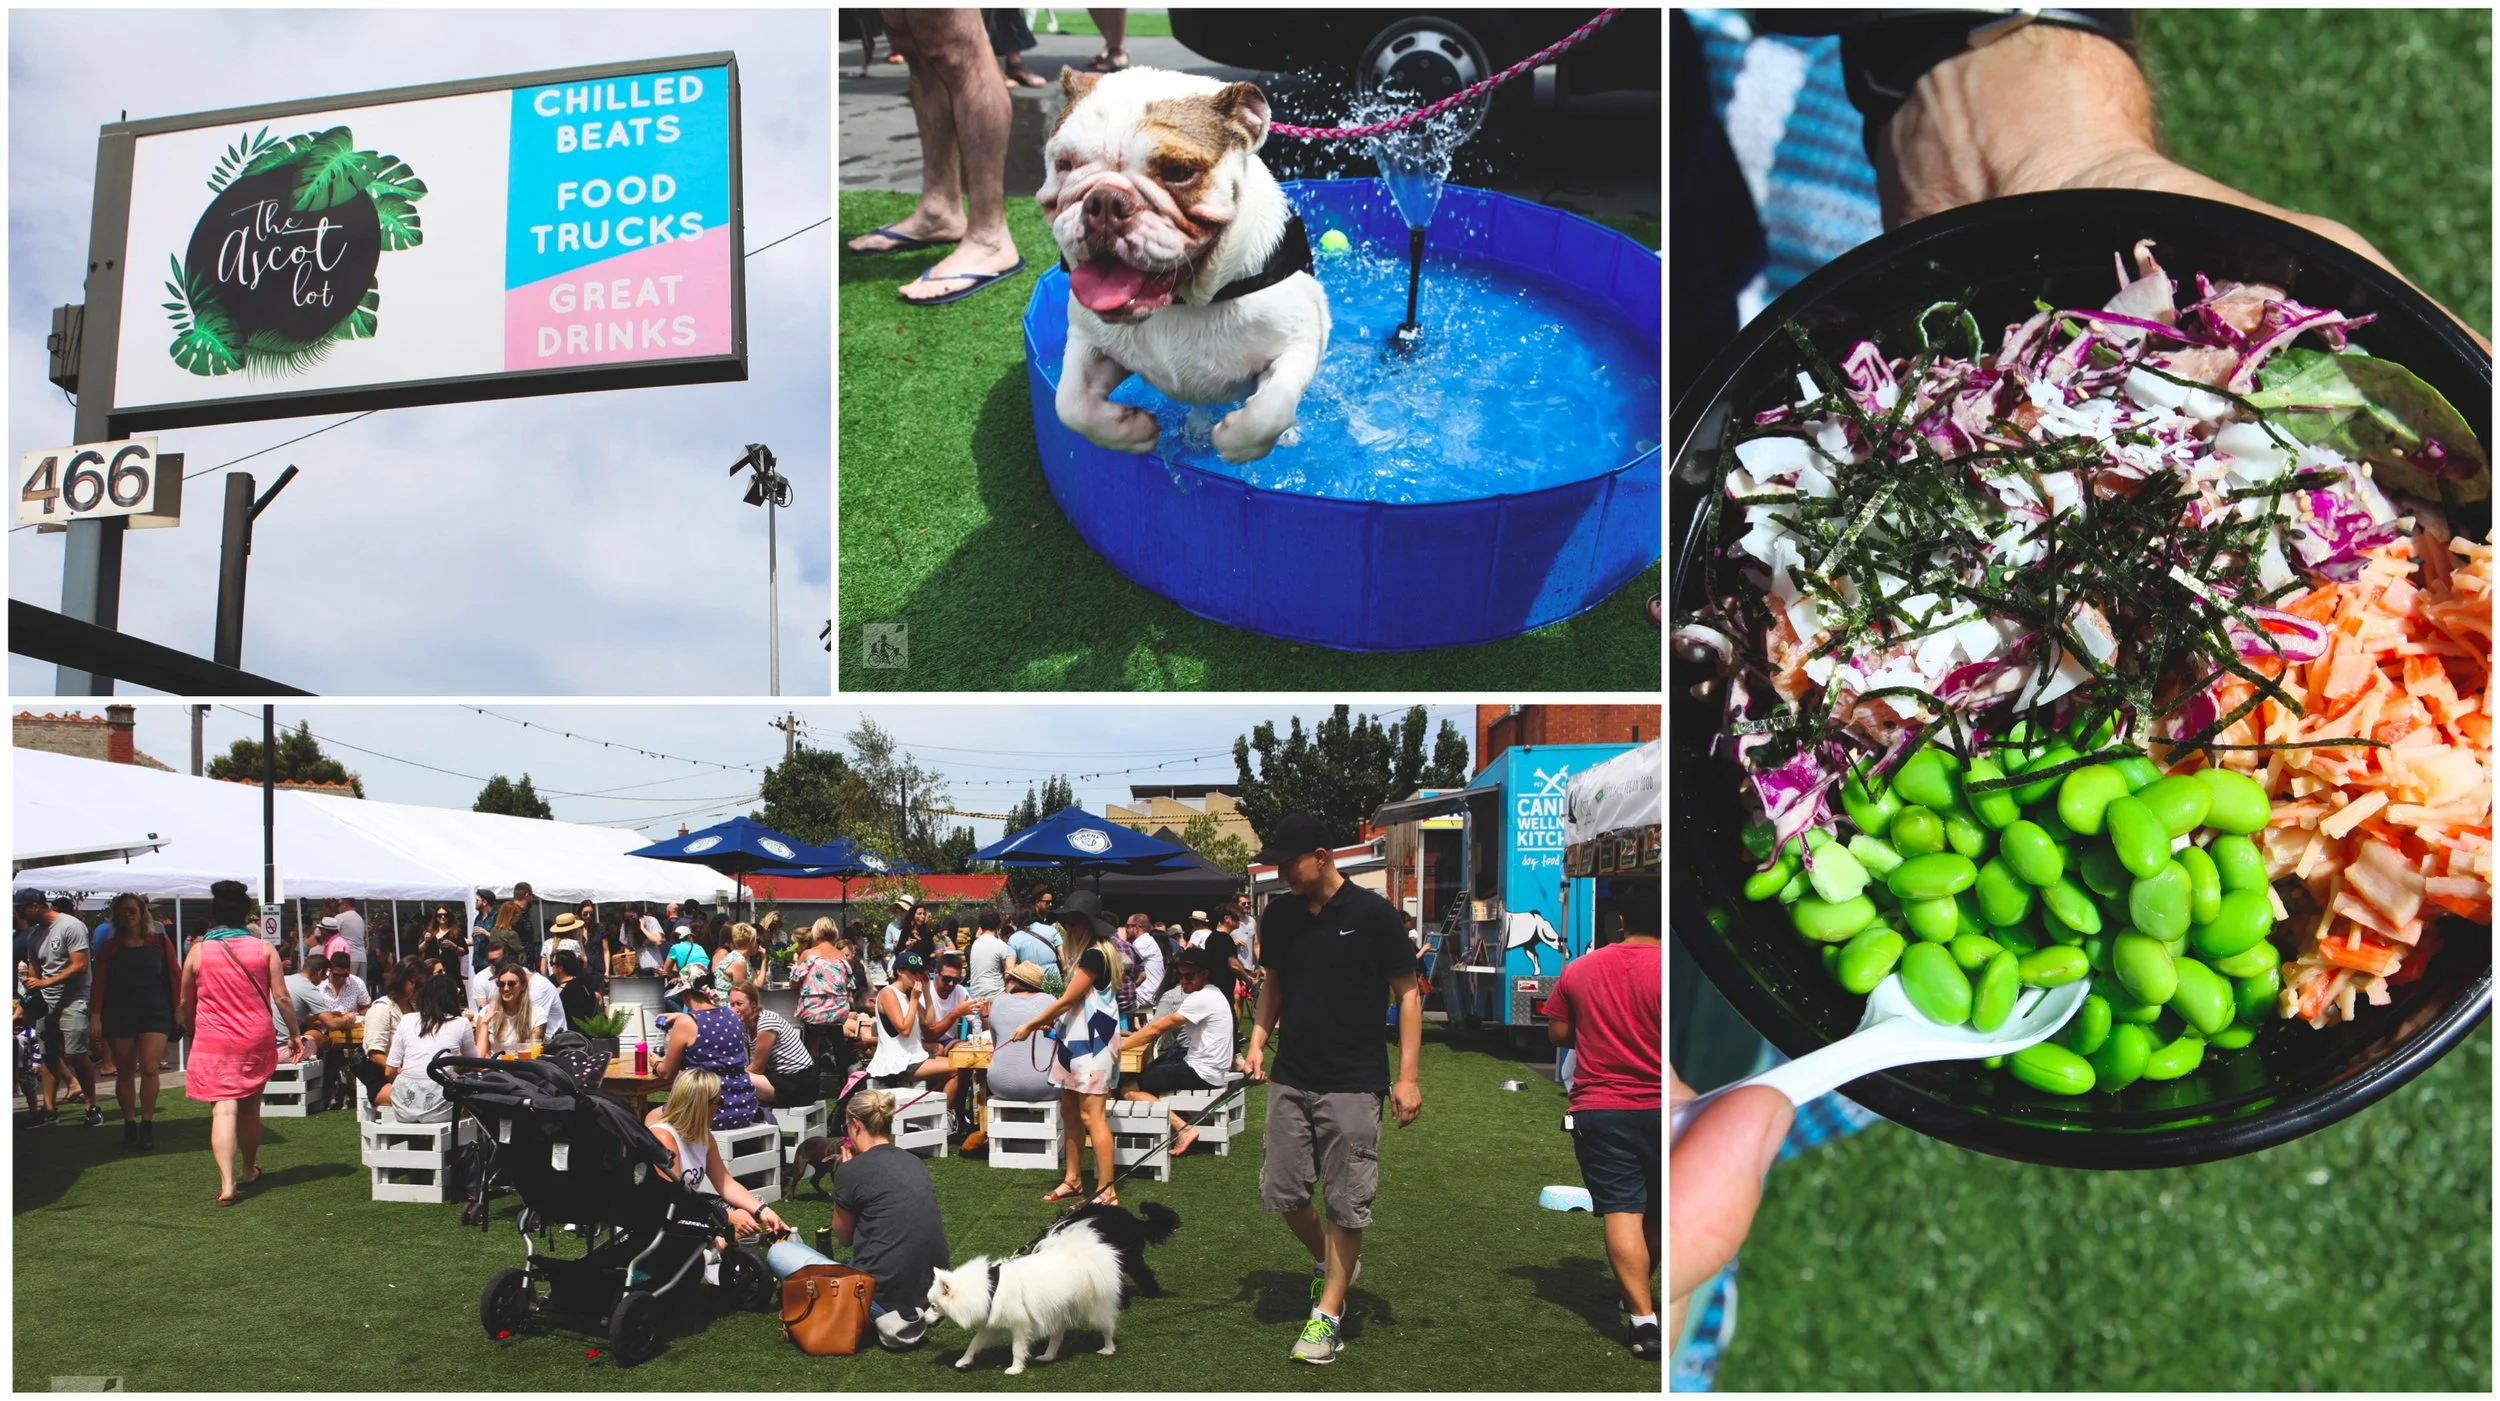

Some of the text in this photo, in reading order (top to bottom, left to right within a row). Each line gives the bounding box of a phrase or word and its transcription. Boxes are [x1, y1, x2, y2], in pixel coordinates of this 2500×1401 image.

[534, 75, 703, 116] CHILLED
[556, 114, 681, 153] BEATS
[557, 174, 676, 211] FOOD
[231, 199, 303, 241] The
[530, 212, 704, 254] TRUCKS
[549, 275, 683, 314] GREAT
[538, 315, 697, 357] DRINKS
[22, 445, 151, 514] 466
[1522, 853, 1560, 871] dog food
